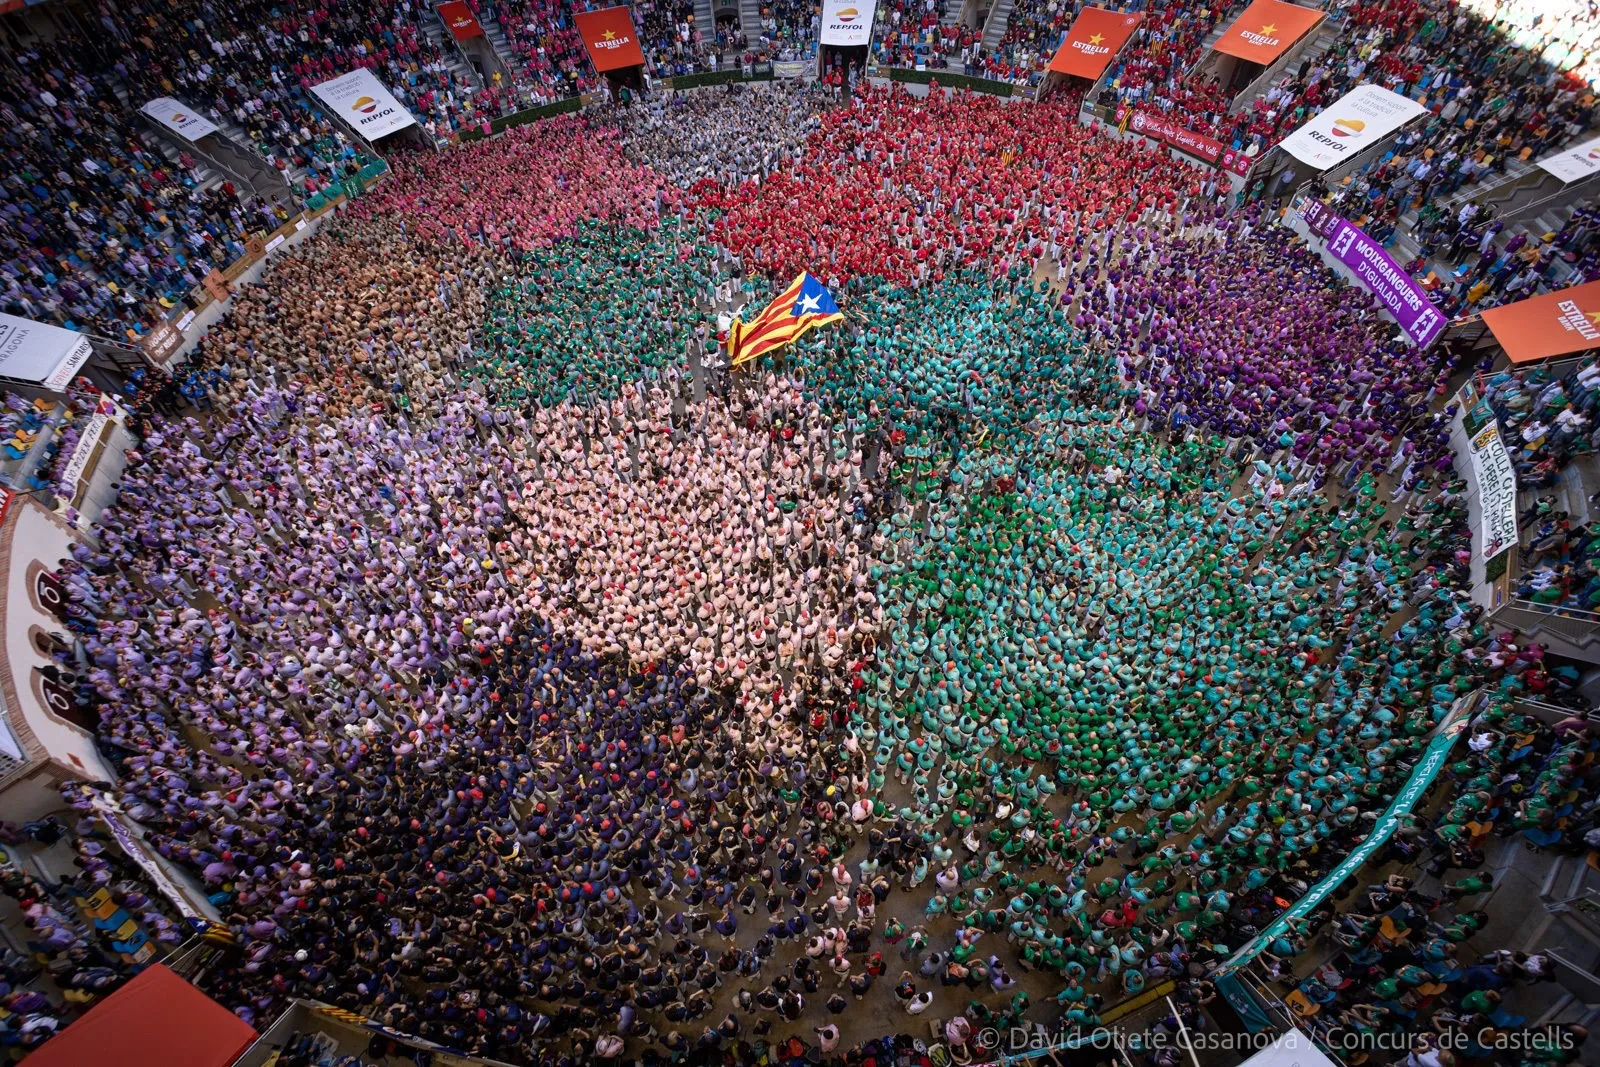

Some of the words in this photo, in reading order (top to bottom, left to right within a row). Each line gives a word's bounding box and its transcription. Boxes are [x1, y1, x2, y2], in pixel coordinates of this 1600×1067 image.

[594, 37, 629, 48] ESTRELLA
[1072, 41, 1109, 54] ESTRELLA
[1240, 30, 1279, 46] ESTRELLA
[360, 107, 396, 125] REPSOL
[1205, 144, 1218, 157] Valls
[1308, 130, 1348, 153] REPSOL
[1355, 239, 1424, 312] MOIXIGANGUERS
[1357, 261, 1403, 314] D'IGUALADA
[1557, 299, 1600, 341] ESTRELLA
[66, 341, 91, 368] SANITARIS
[1485, 462, 1500, 492] PERE
[1491, 441, 1510, 477] COLLA
[1501, 476, 1516, 545] CASTELLERA
